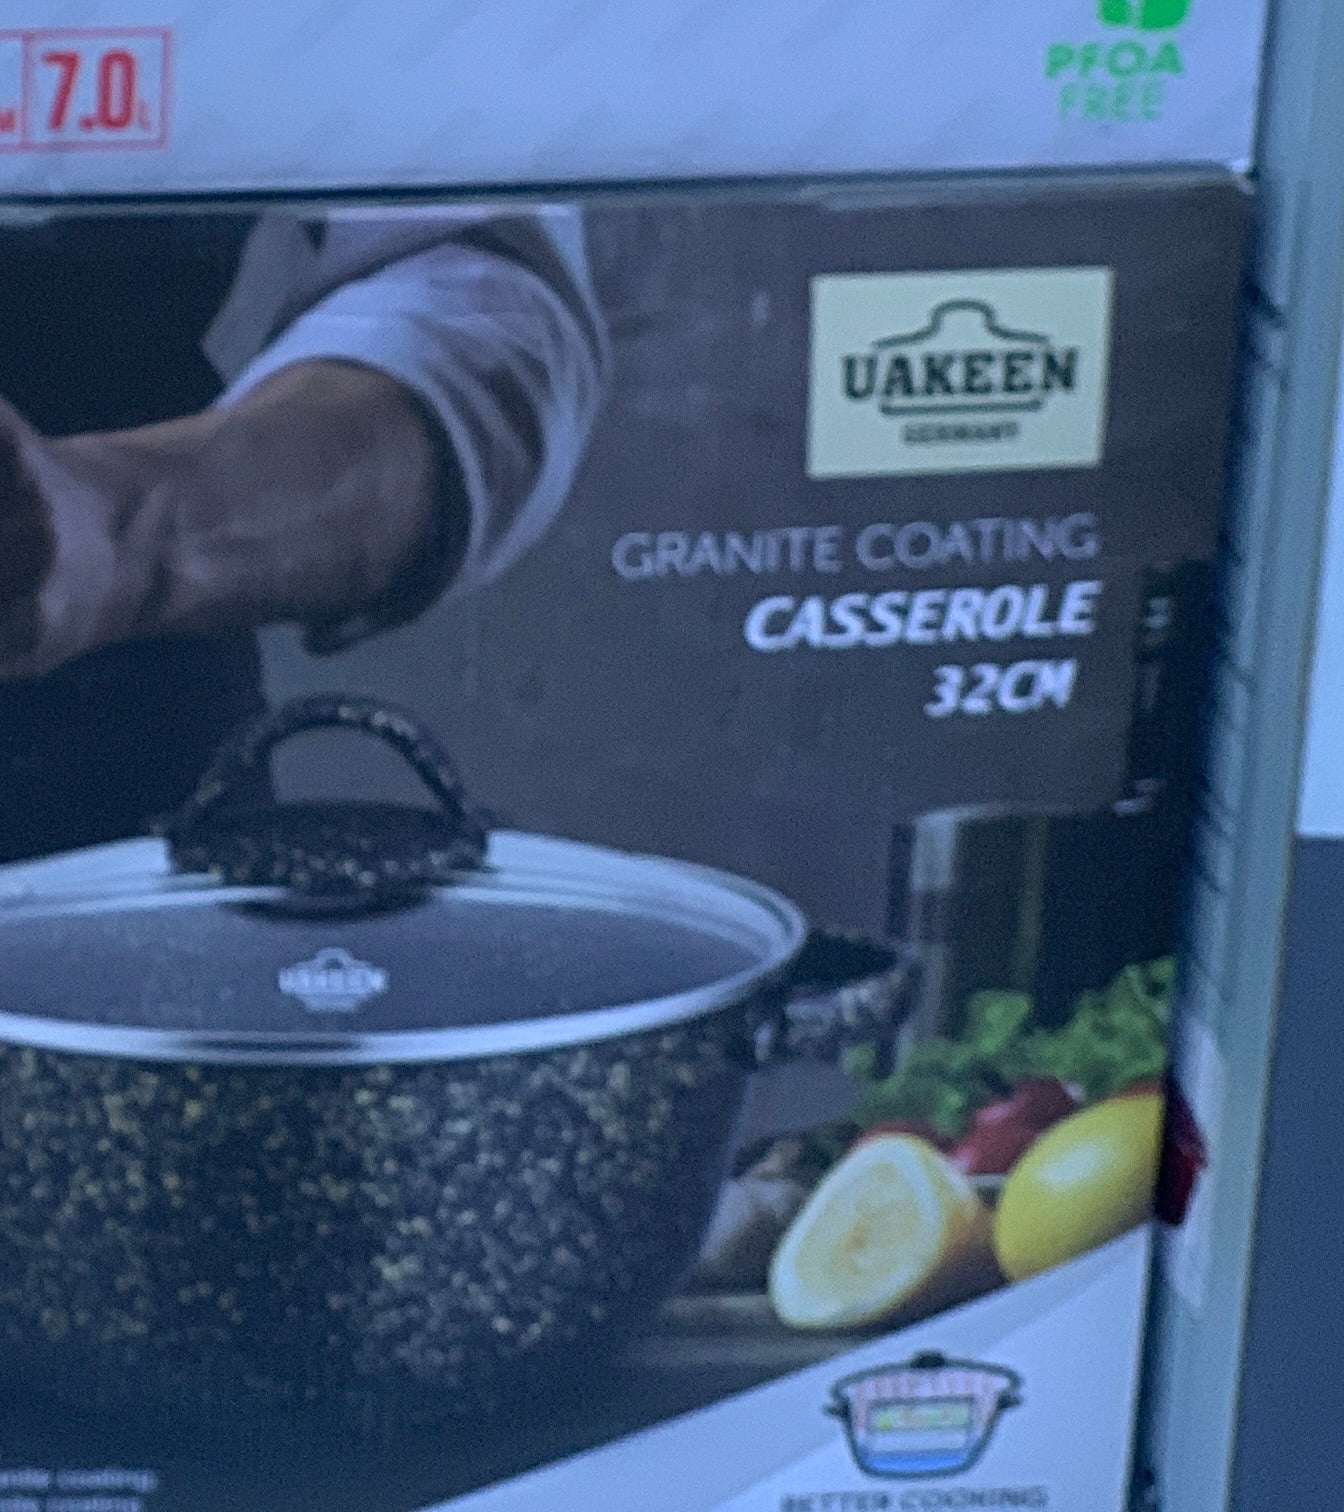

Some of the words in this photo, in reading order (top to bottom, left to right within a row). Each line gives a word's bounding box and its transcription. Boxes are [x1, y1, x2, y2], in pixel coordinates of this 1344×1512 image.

[1044, 39, 1184, 80] PFOA
[611, 525, 841, 582] GRANITE
[855, 513, 1102, 571] COATING
[745, 580, 1103, 652] CASSEROLE
[925, 659, 1077, 719] 32CM
